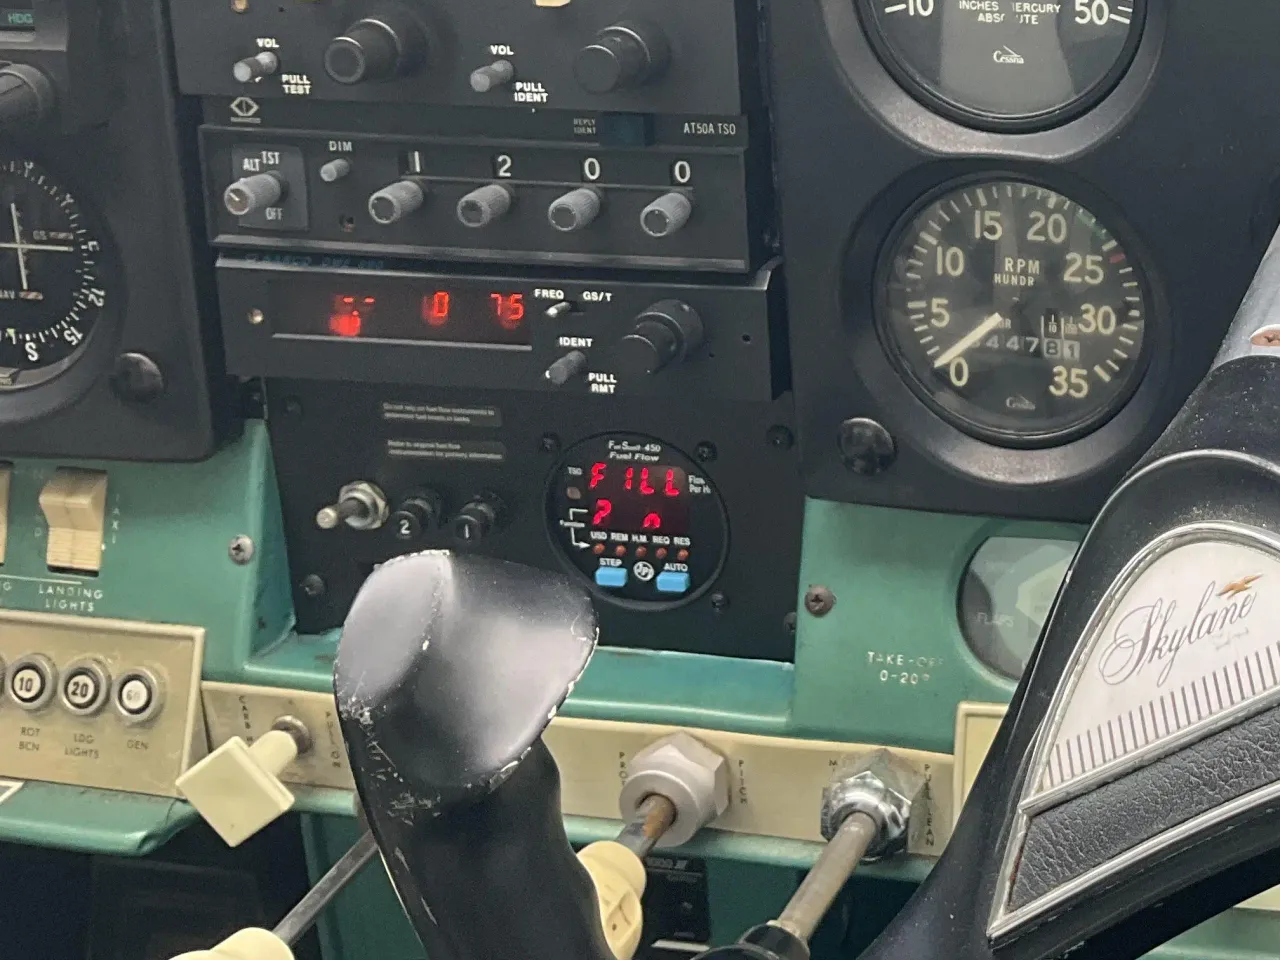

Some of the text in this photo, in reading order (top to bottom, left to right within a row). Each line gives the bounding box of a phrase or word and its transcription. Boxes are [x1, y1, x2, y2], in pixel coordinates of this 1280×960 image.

[959, 0, 999, 11] INCHES
[8, 13, 33, 23] HDG
[256, 38, 279, 48] VOL
[490, 45, 514, 56] VOL
[994, 49, 1024, 64] Cessna
[282, 74, 311, 84] PULL
[283, 84, 311, 94] TEST
[515, 82, 545, 92] PULL
[514, 92, 548, 103] IDENT
[684, 122, 736, 135] AT50A TSO
[329, 141, 353, 151] DIM
[261, 151, 280, 164] TST
[243, 158, 260, 171] ALT
[497, 155, 691, 183] 2 0 0
[265, 207, 283, 221] OFF
[974, 210, 1003, 240] 15
[1027, 212, 1067, 243] 20
[936, 246, 963, 276] 10
[1005, 257, 1040, 275] RPM
[1063, 252, 1104, 285] 25
[994, 273, 1034, 286] HUNDR
[88, 288, 105, 307] 12
[534, 289, 564, 300] FREQ
[582, 291, 612, 302] GS/T
[931, 297, 949, 328] 5
[1078, 303, 1117, 335] 30
[63, 326, 84, 345] 15
[559, 337, 593, 348] IDENT
[24, 342, 40, 361] S
[949, 357, 968, 386] 0
[588, 373, 617, 384] PULL
[1049, 365, 1088, 398] 35
[591, 384, 615, 394] RMT
[400, 520, 411, 534] 2
[590, 531, 607, 540] USD
[610, 532, 628, 542] REM
[652, 535, 670, 545] REQ
[673, 536, 691, 546] RES
[599, 557, 622, 567] STEP
[663, 562, 688, 572] AUTO
[39, 584, 103, 599] LANDING
[45, 600, 95, 613] LIGHTS
[1098, 580, 1259, 687] Skylane
[19, 677, 33, 692] 10
[71, 681, 89, 698] 20
[20, 727, 41, 737] ROT
[73, 733, 95, 744] LDG
[127, 739, 149, 750] GEN
[19, 741, 40, 752] BCN
[64, 747, 100, 759] LIGHTS
